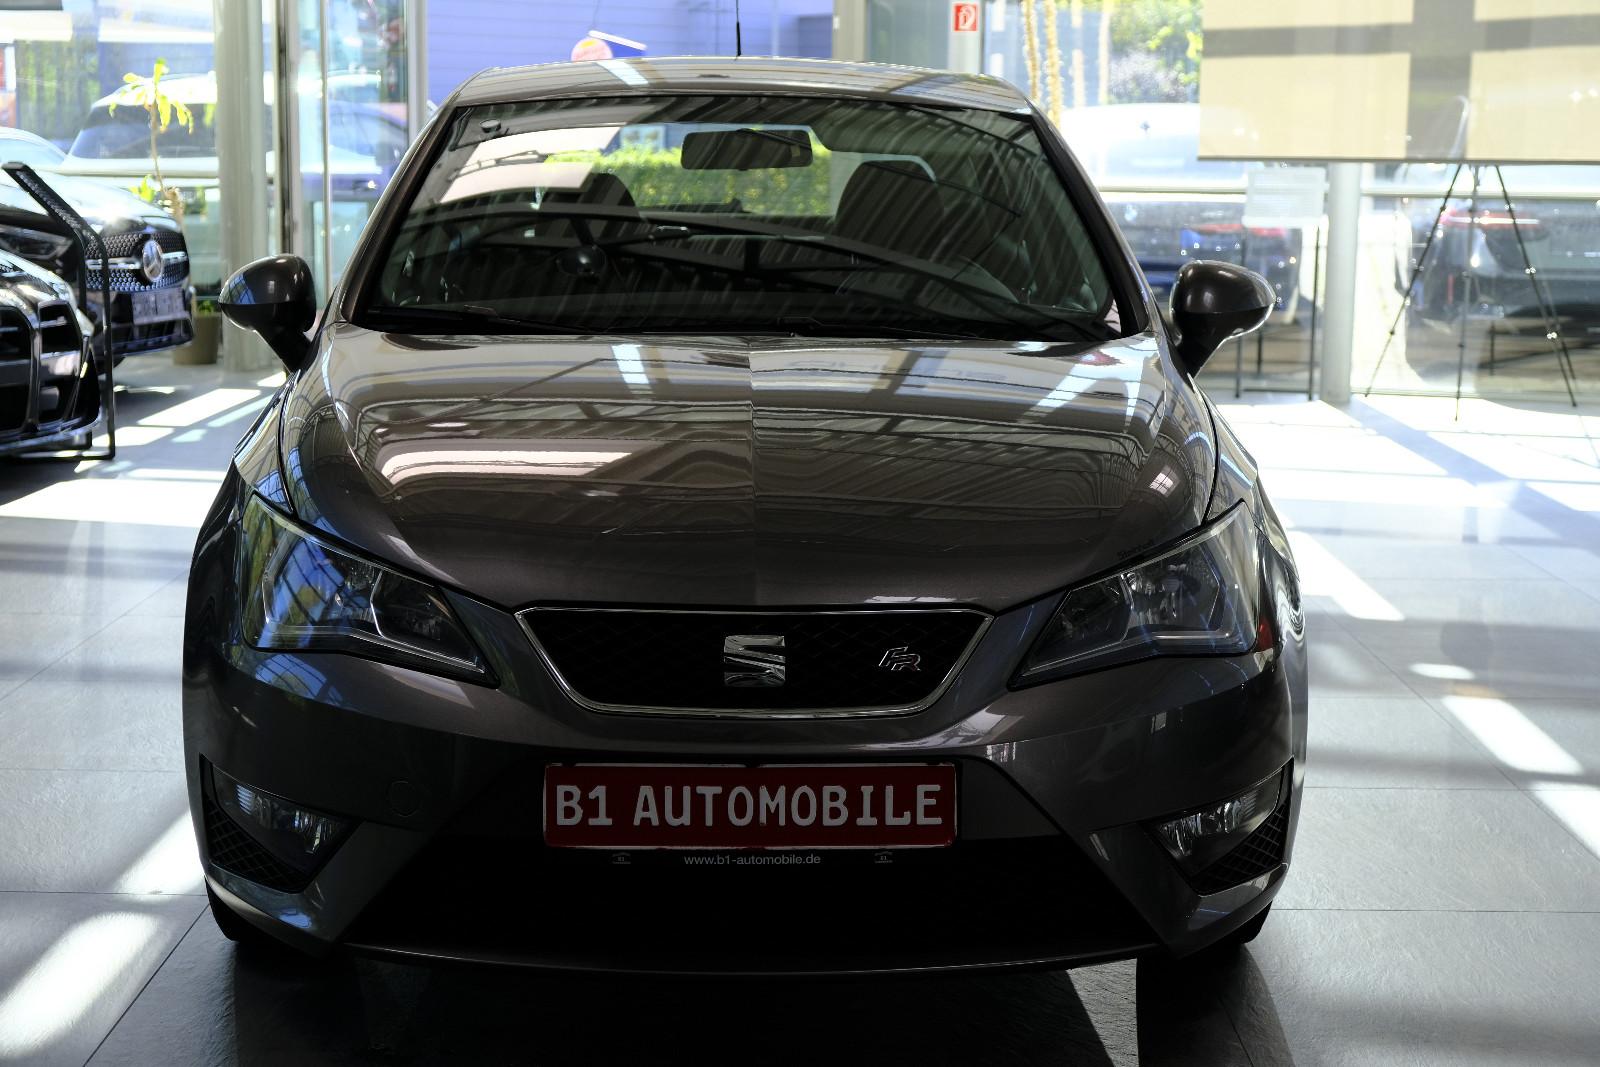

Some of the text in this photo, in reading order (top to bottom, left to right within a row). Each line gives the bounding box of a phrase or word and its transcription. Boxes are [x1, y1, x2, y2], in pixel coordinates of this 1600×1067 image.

[878, 645, 921, 671] FR
[556, 784, 943, 827] B1 AUTOMOBILE
[684, 853, 822, 866] www.b1-automobile.de
